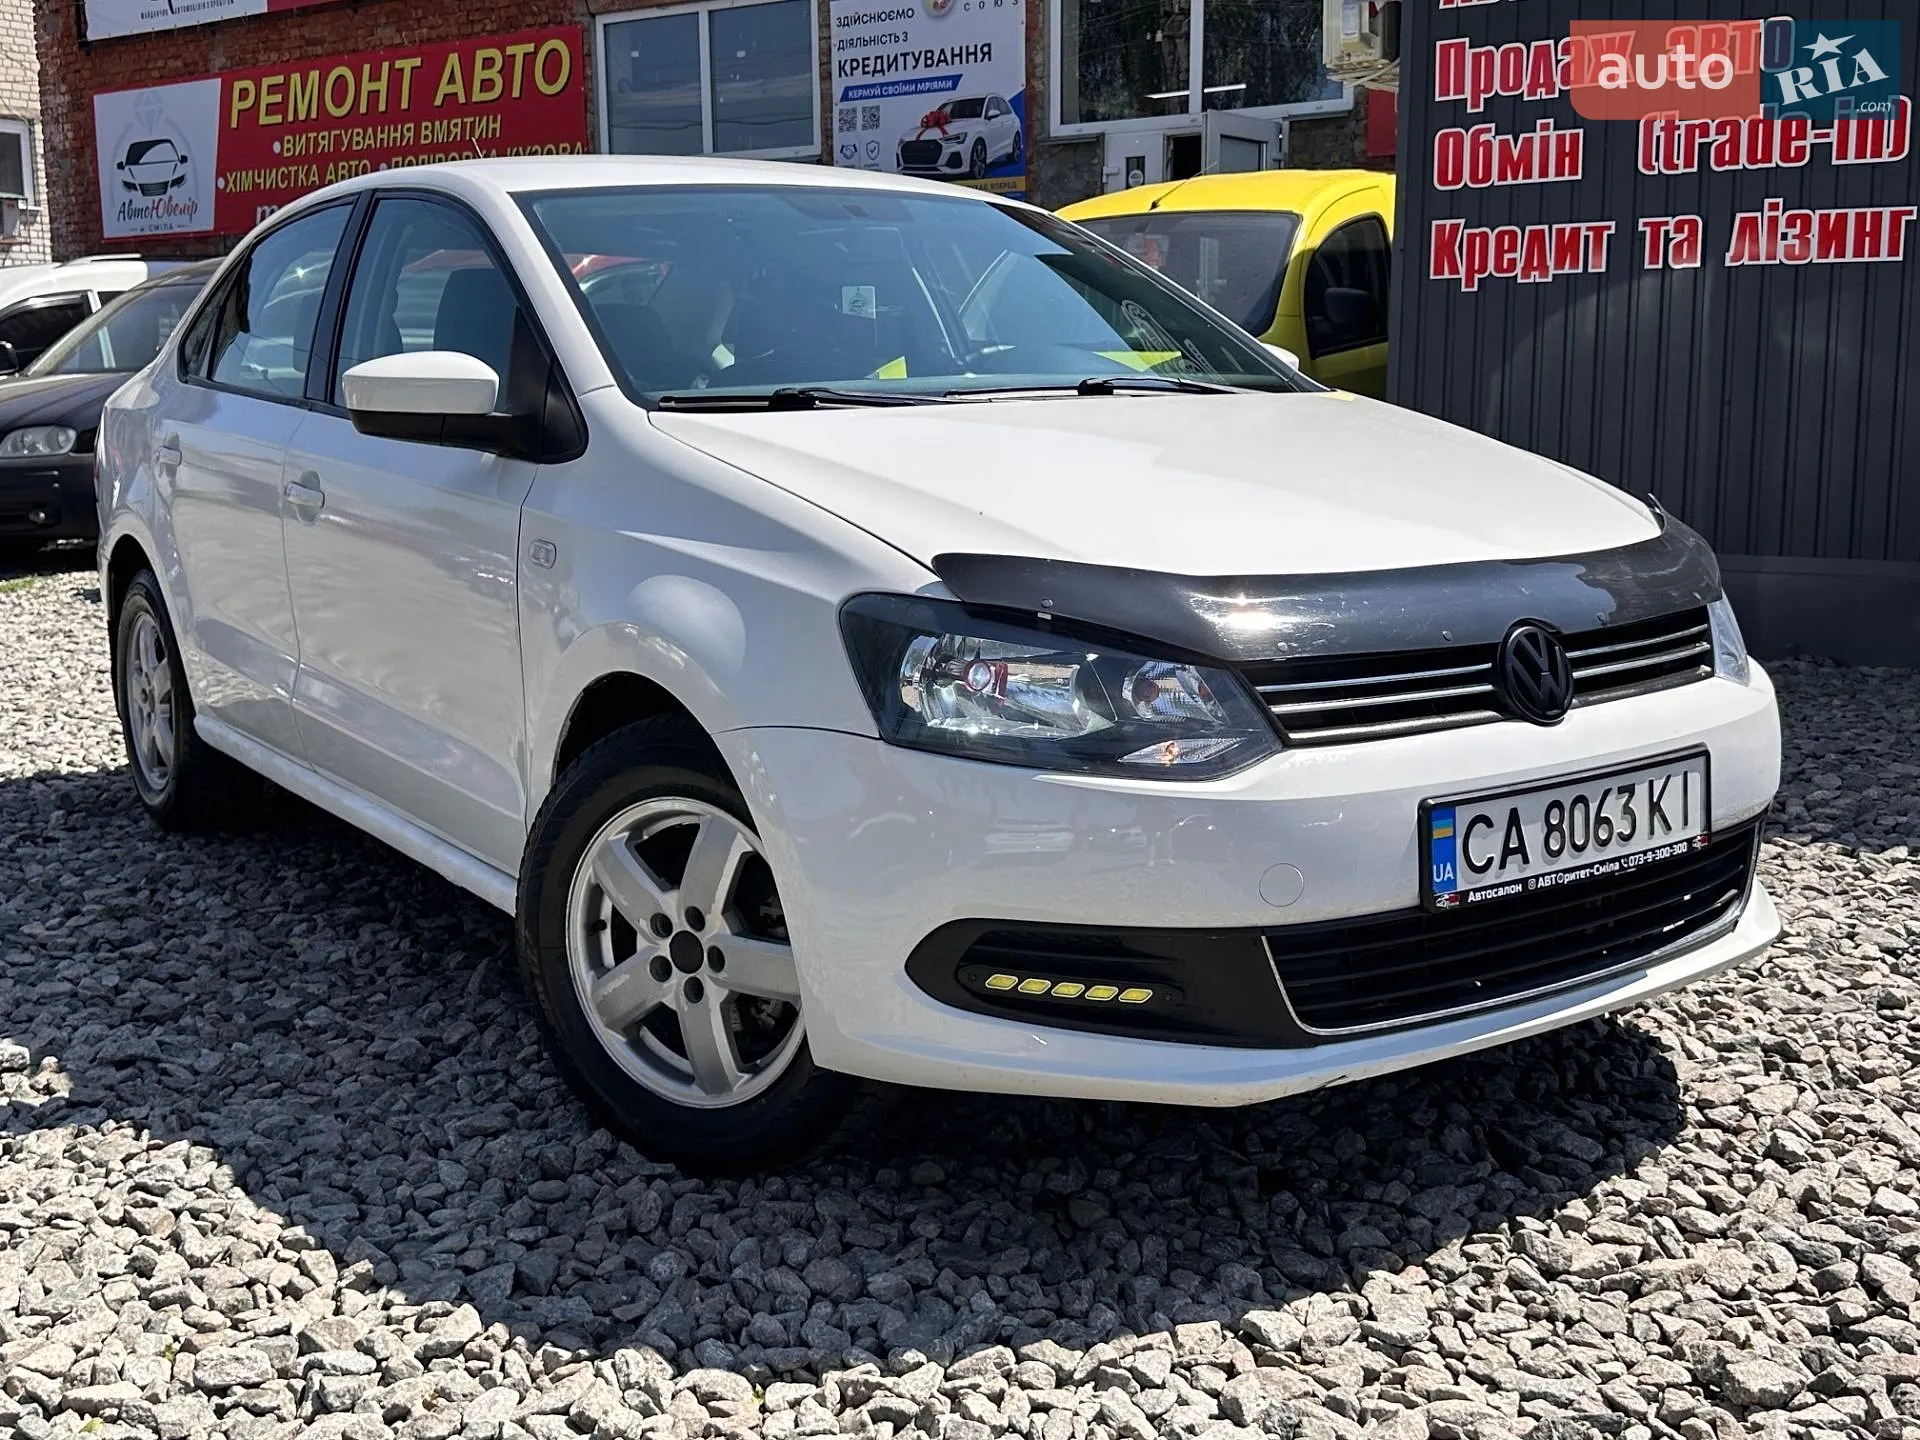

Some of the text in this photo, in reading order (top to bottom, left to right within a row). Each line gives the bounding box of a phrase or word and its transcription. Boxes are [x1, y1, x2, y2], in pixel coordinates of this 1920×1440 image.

[836, 7, 915, 29] ЗДІЙСНЮЄМО
[837, 31, 909, 52] ДІЯЛЬНІСТЬ З
[838, 43, 992, 79] КРЕДИТУВАННЯ
[229, 38, 572, 129] РЕМОНТ АВТО
[848, 79, 953, 100] КЕРМУЙ СВОЇМИ МРІЯМИ
[282, 114, 501, 158] ВИТЯГУВАННЯ ВМЯТИН
[1434, 94, 1912, 191] Обмін (trade-in)
[226, 164, 320, 193] ХІМЧИСТКА
[325, 159, 371, 184] АВТО
[117, 196, 198, 224] АвтоЮвелір
[1429, 198, 1918, 293] Кредит та лізинг
[1462, 769, 1690, 875] CA 8063 KI
[1432, 861, 1455, 883] UA
[1467, 882, 1523, 903] Автосалон
[1628, 842, 1688, 868] 073-9-300-300
